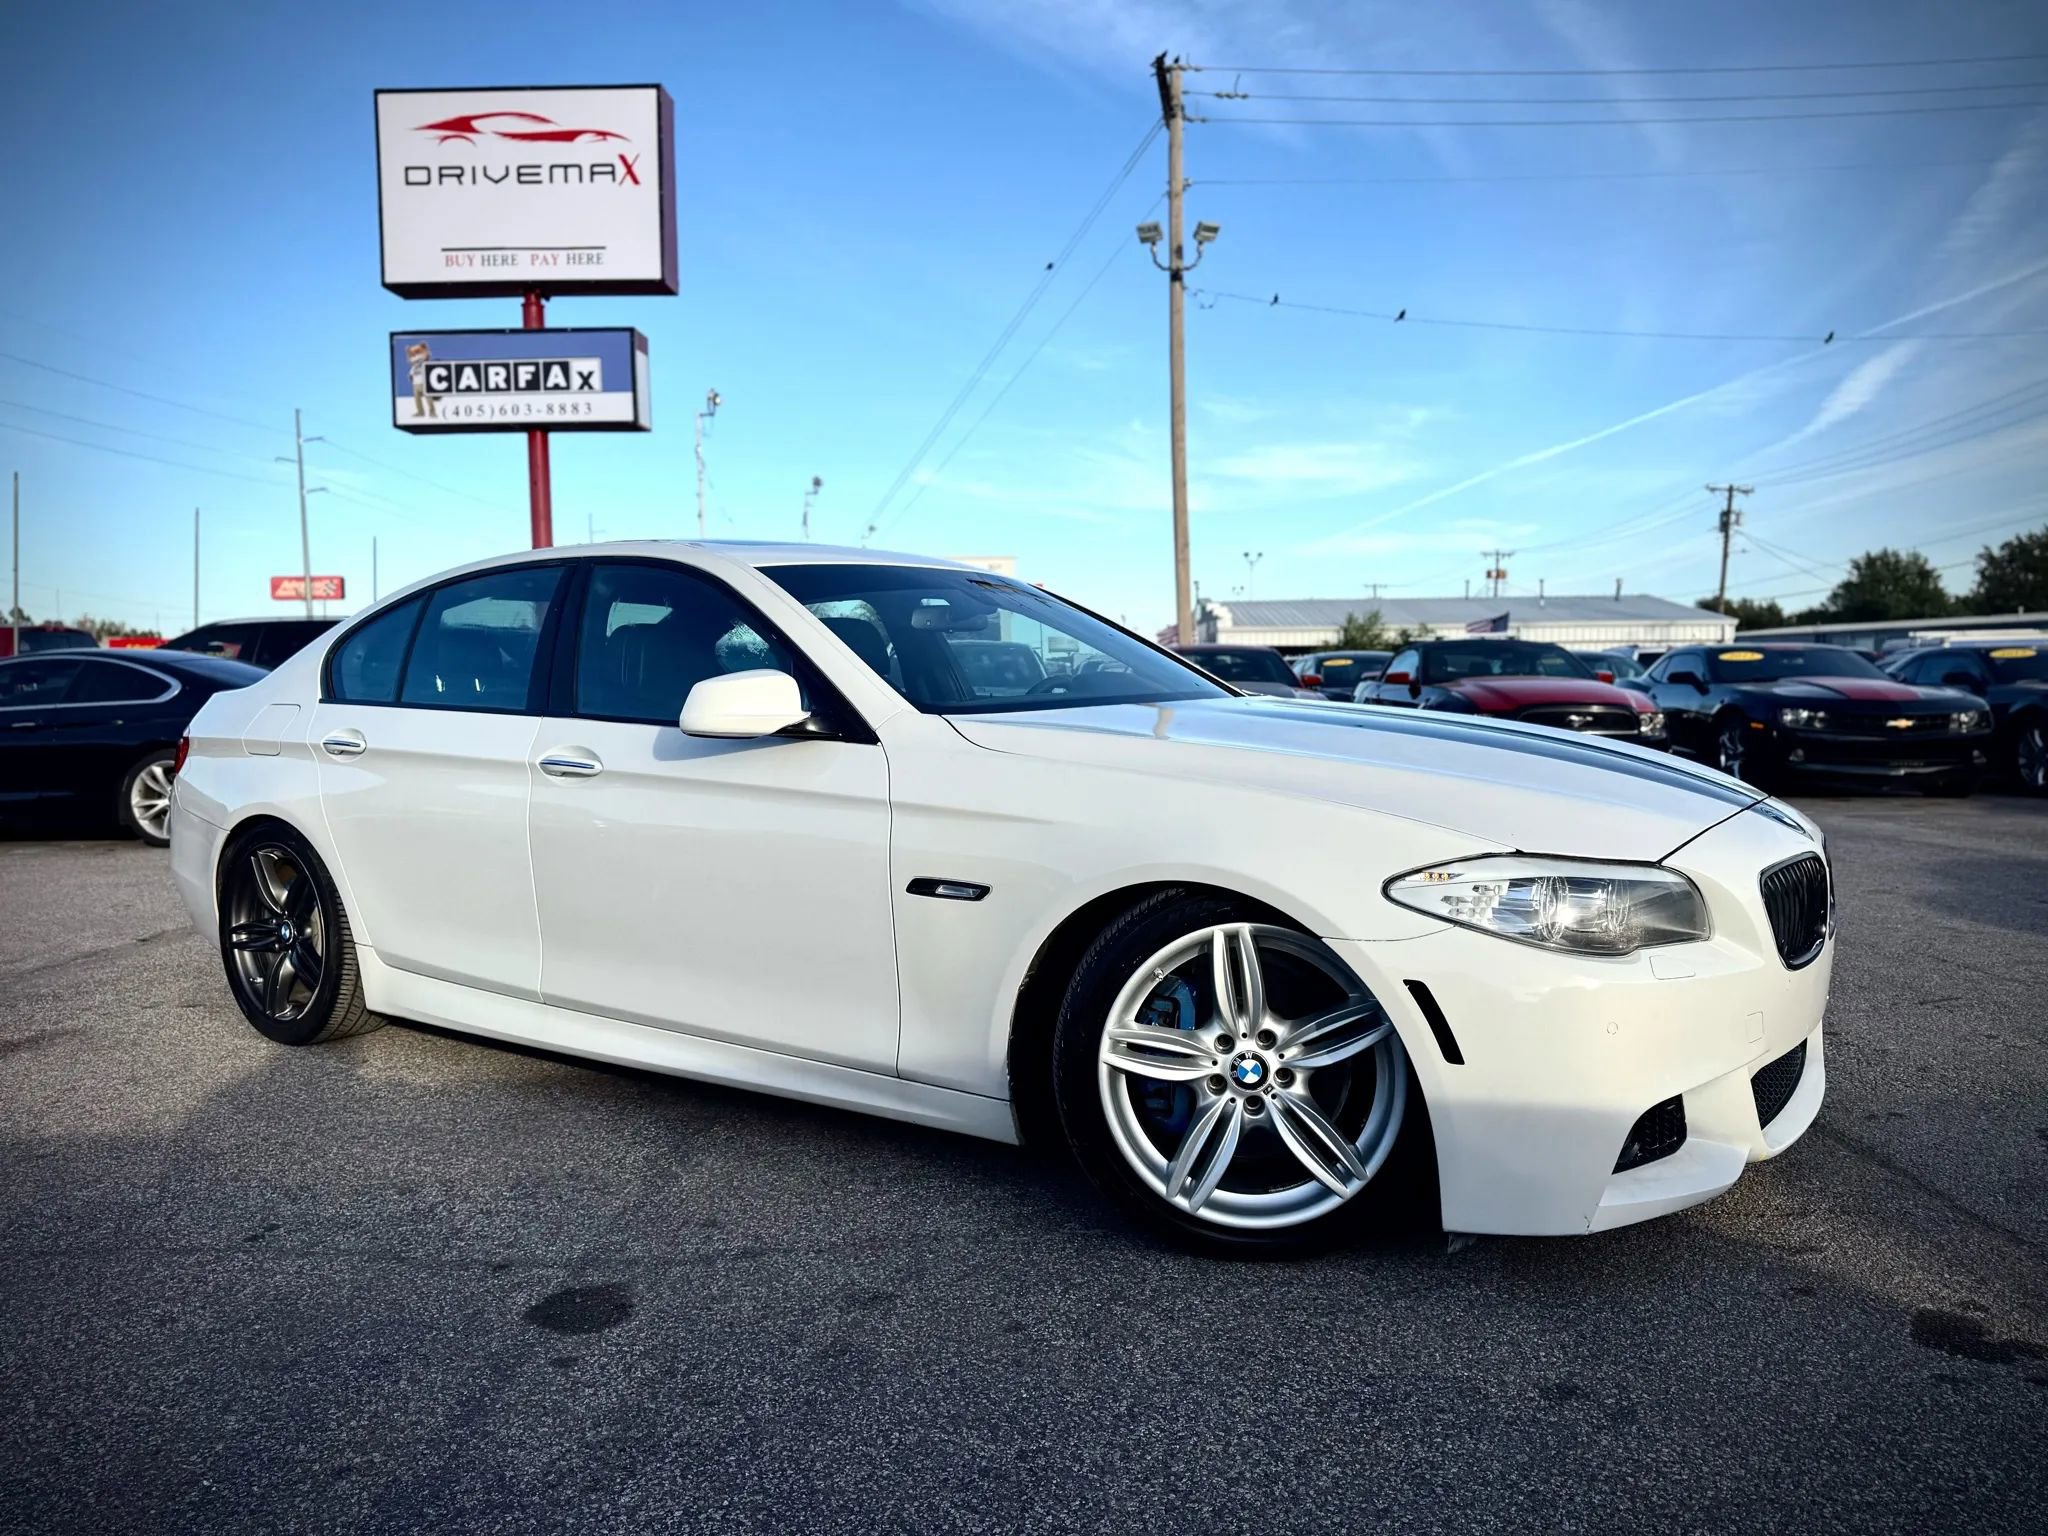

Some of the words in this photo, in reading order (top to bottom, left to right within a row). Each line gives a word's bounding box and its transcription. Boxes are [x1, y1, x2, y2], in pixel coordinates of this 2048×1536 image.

[404, 153, 641, 185] DRIVEMAX
[445, 254, 475, 267] BUY
[481, 253, 519, 267] HERE
[530, 253, 560, 266] PAY
[566, 252, 604, 265] HERE
[428, 363, 596, 391] CARFAX
[442, 402, 593, 419] (405)603-8883
